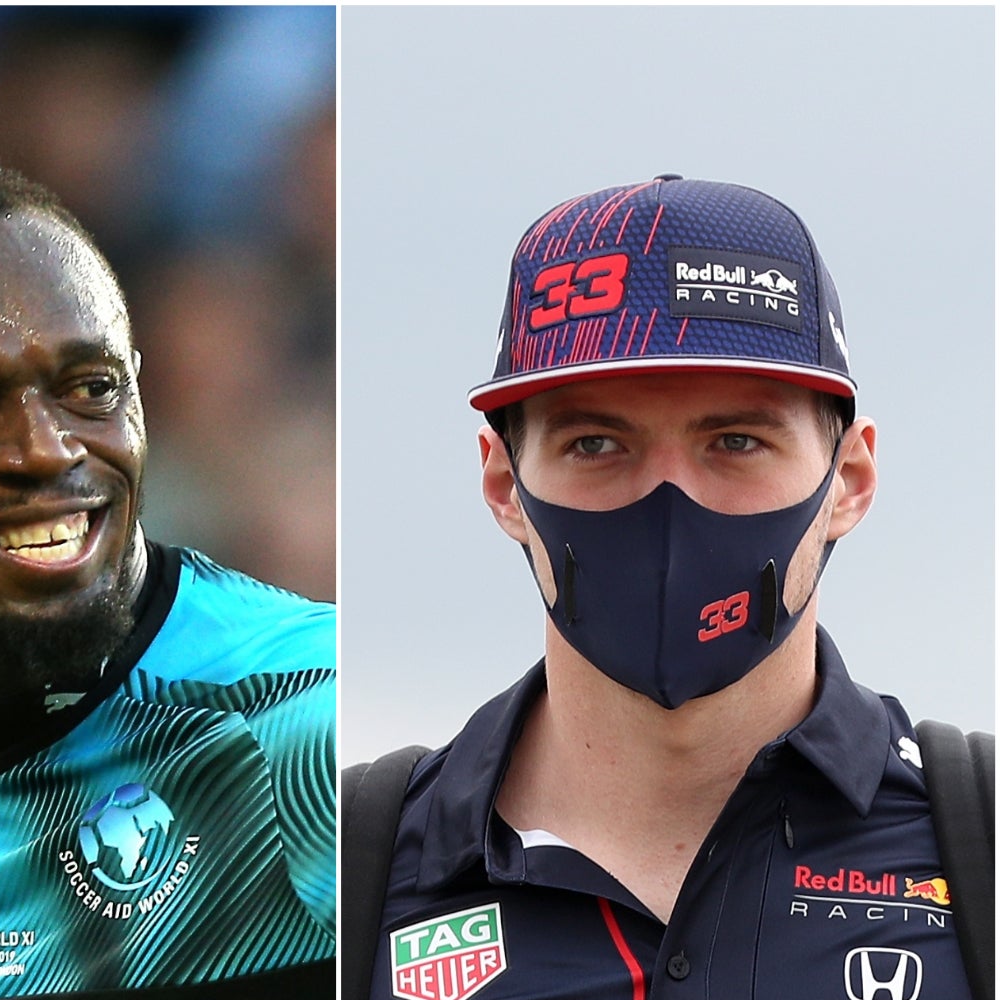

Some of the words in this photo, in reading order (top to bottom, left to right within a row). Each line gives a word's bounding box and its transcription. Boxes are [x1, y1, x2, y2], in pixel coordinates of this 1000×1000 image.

[528, 252, 630, 329] 33
[675, 262, 712, 282] Red
[713, 264, 745, 285] Bull
[676, 287, 799, 316] RACING
[698, 591, 750, 642] 33
[59, 850, 102, 912] SOCCER
[101, 902, 132, 919] AID
[137, 860, 189, 915] WORLD
[183, 835, 200, 855] XI
[794, 865, 845, 892] Red
[848, 870, 896, 896] Bull
[21, 931, 35, 946] XI
[400, 914, 491, 960] TAG
